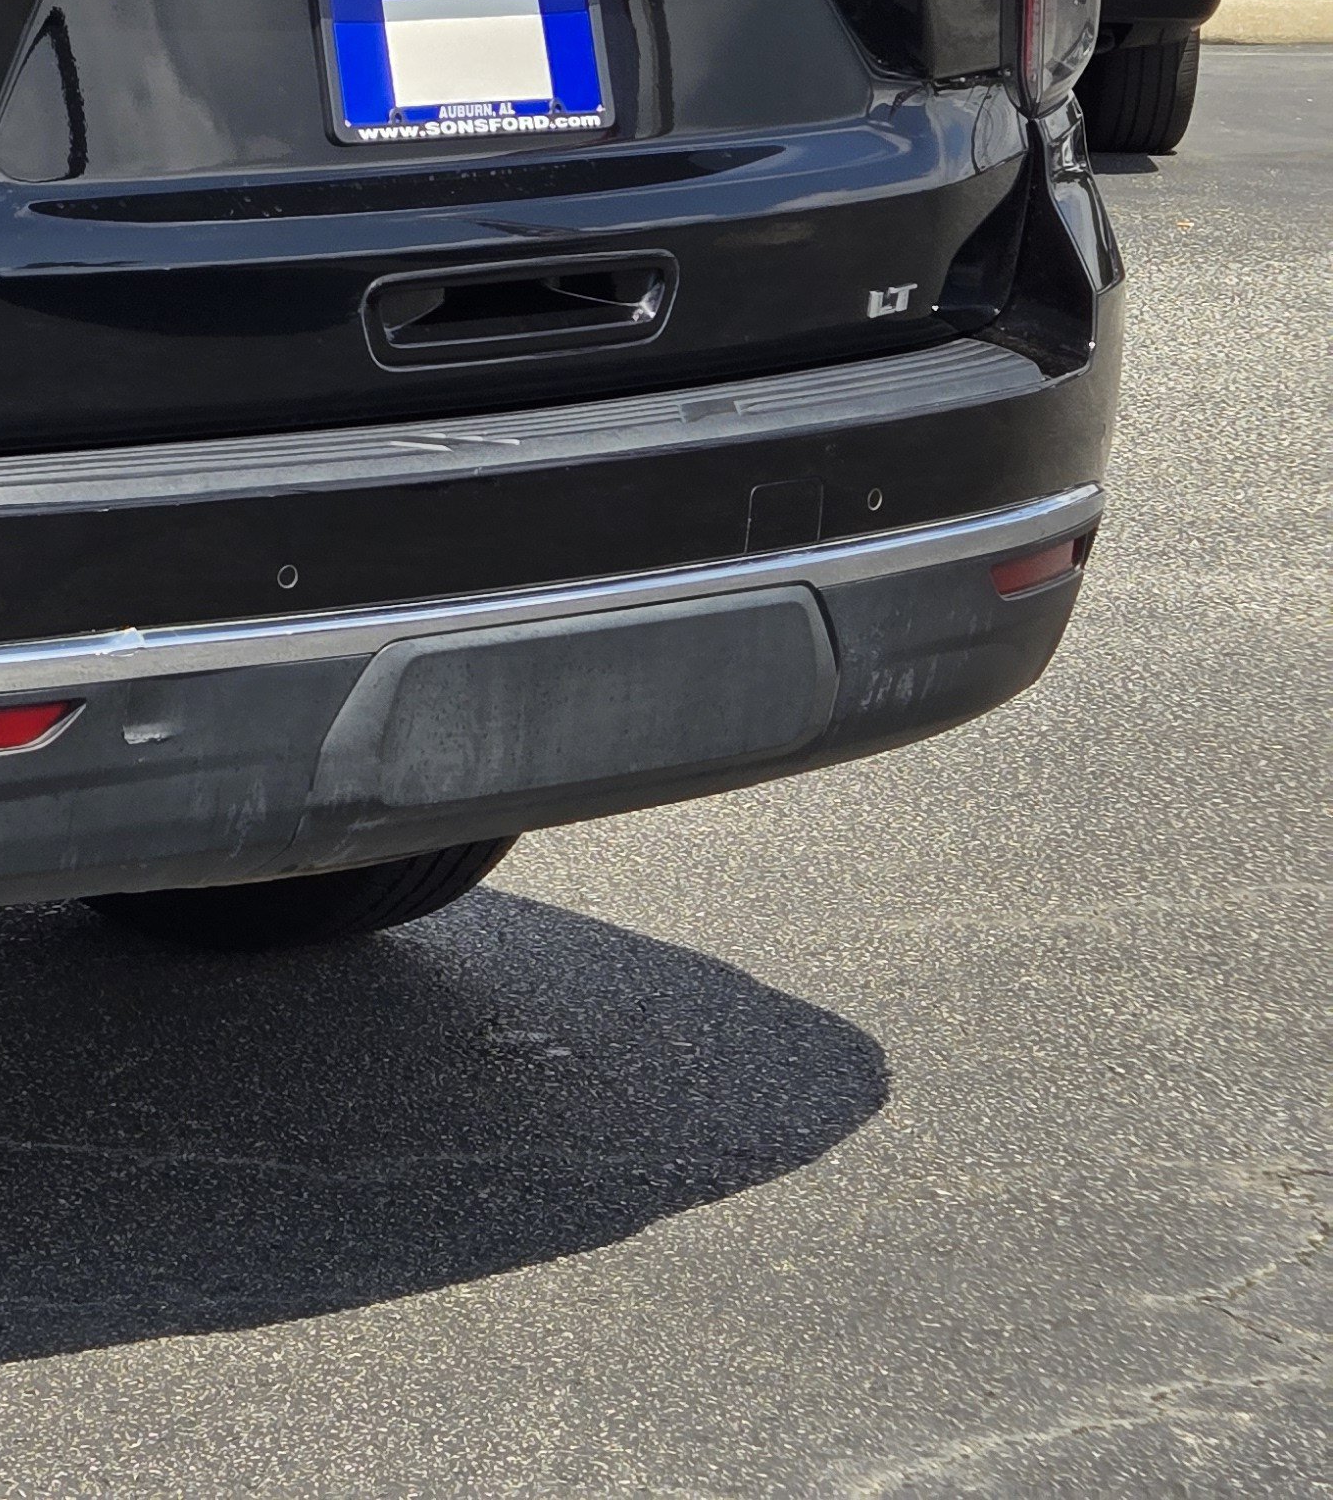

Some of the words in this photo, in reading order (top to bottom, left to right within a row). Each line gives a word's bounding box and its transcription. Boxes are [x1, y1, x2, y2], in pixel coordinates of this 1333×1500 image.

[439, 103, 496, 119] AUBURN,
[499, 102, 515, 115] AL
[358, 113, 601, 140] www.SONSFORD.com
[867, 283, 918, 318] LT
